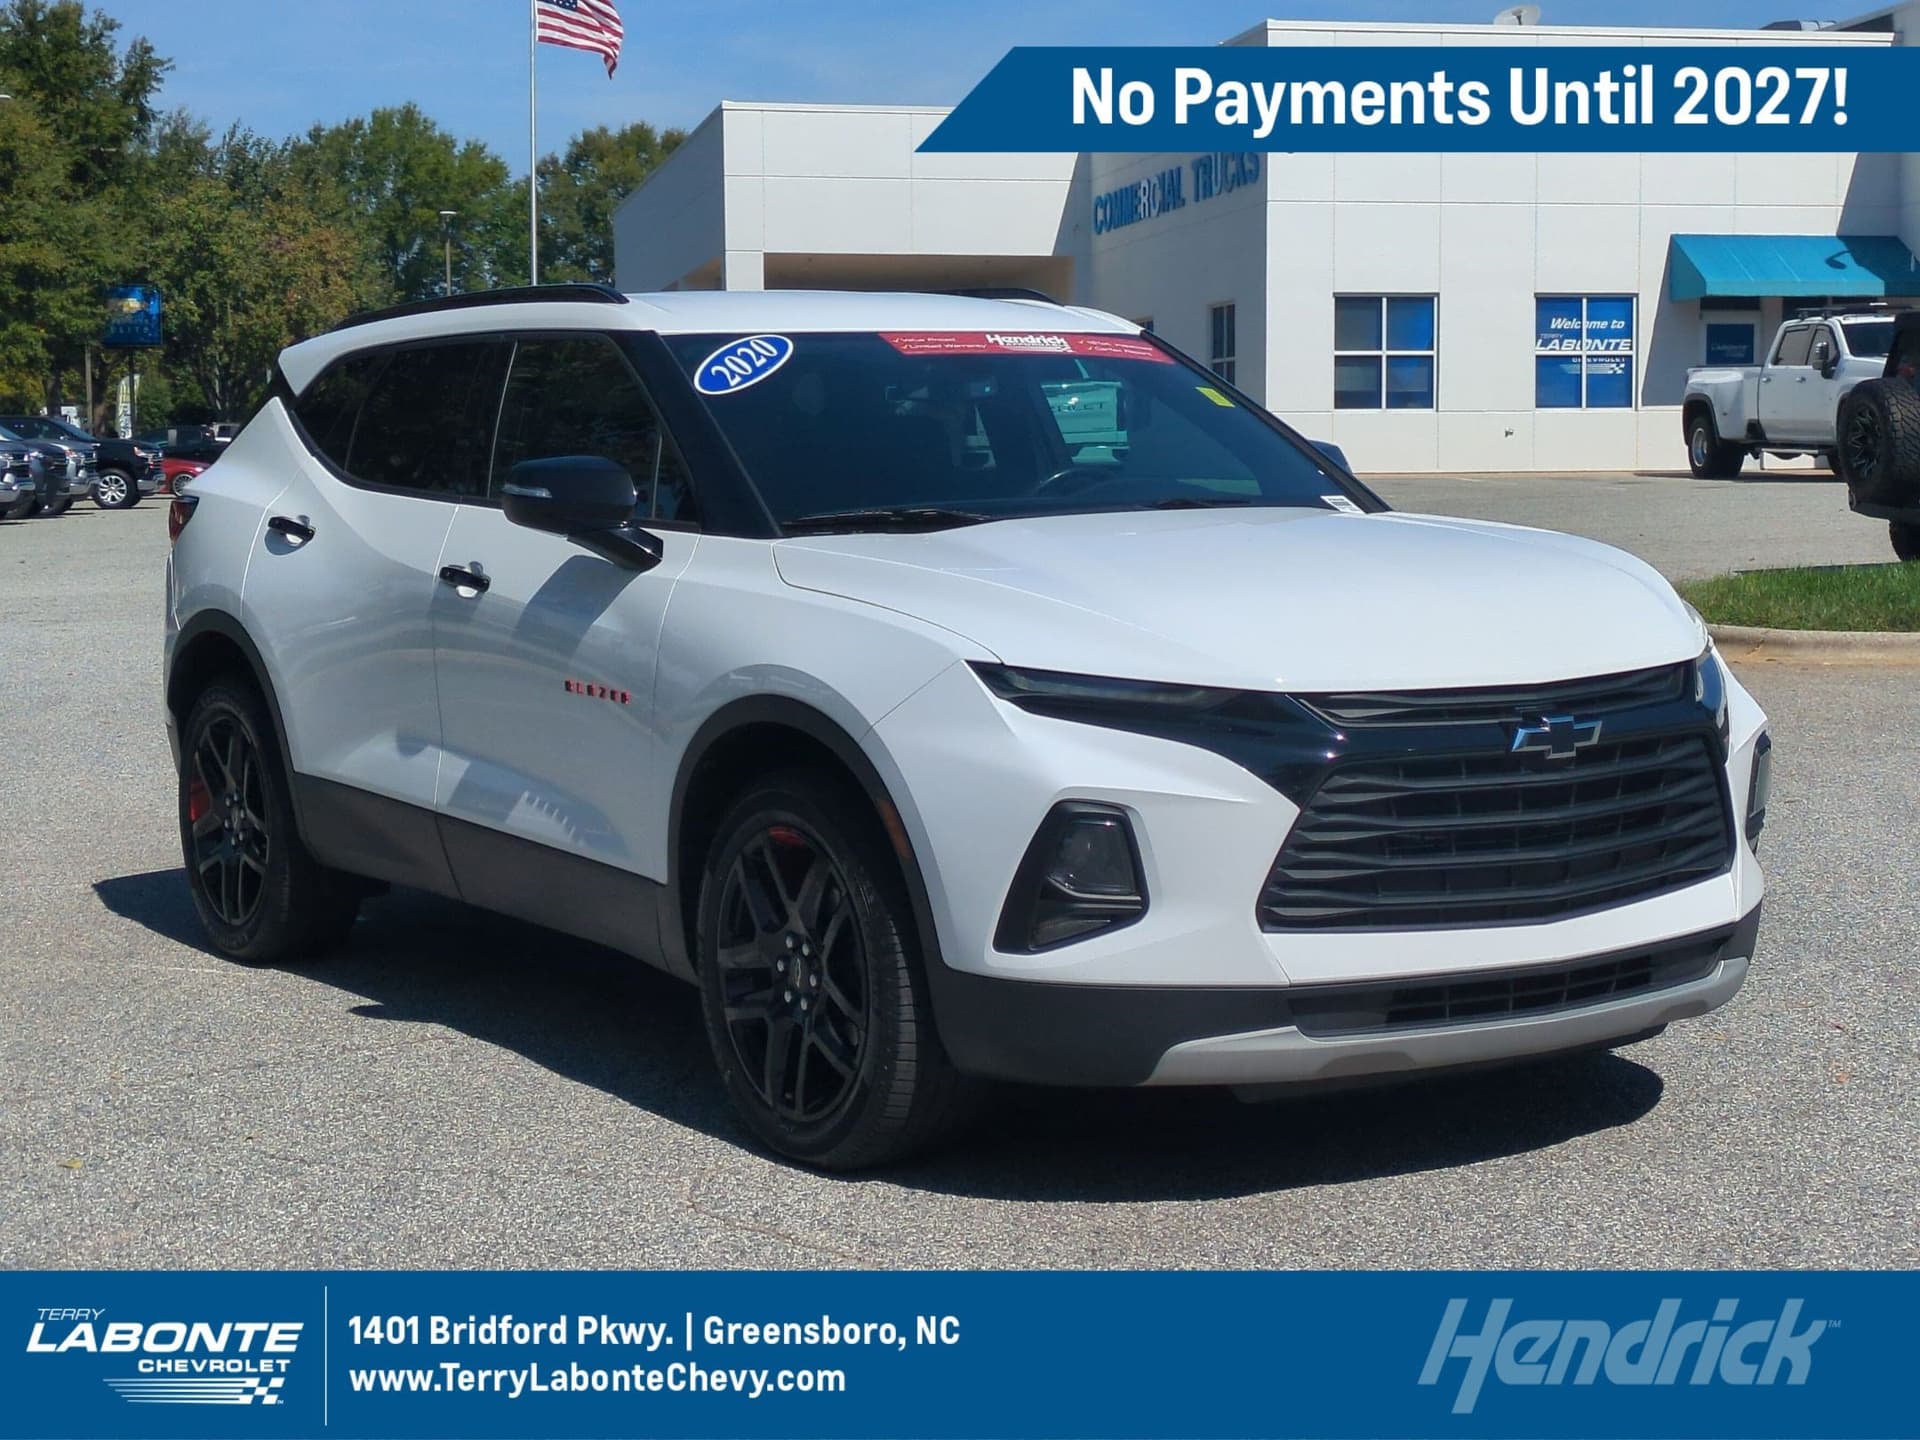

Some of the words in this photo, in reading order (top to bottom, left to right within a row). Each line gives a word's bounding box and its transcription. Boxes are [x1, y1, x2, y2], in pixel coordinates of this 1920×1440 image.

[1093, 165, 1187, 235] COMMERCIAL
[1191, 151, 1261, 203] TRUCKS
[1611, 319, 1625, 329] to
[985, 334, 1068, 348] Hendrick
[1535, 339, 1632, 351] LABONTE
[710, 338, 778, 387] 2020
[563, 678, 633, 705] BLAZER
